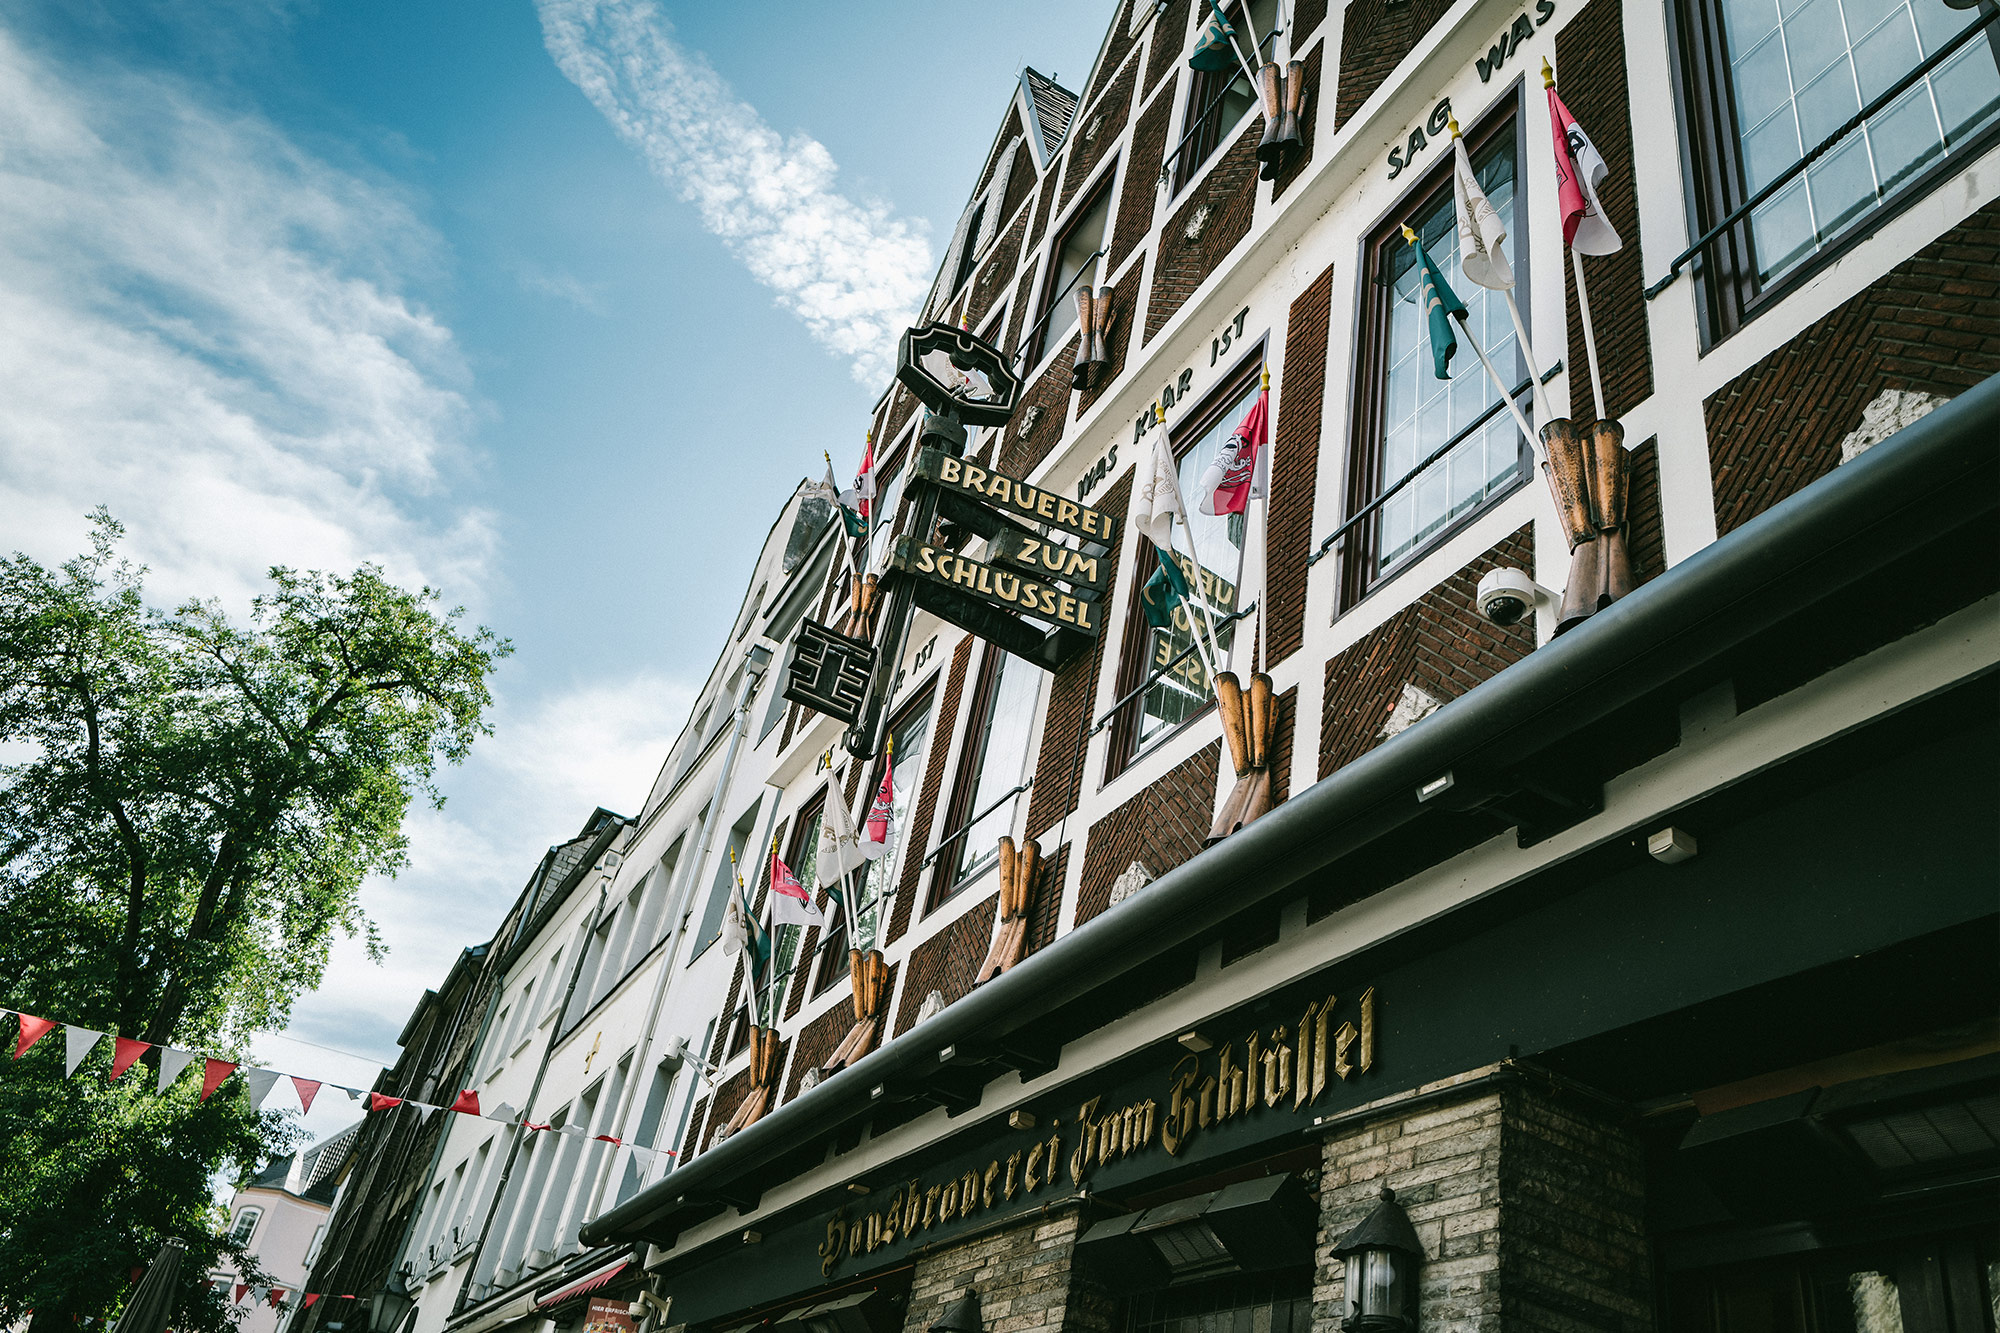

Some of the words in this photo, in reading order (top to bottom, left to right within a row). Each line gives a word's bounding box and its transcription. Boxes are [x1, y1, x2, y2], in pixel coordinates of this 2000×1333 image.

[1387, 97, 1452, 181] SAG
[1475, 0, 1555, 83] WAS
[1077, 444, 1119, 503] WAS
[1133, 367, 1194, 445] KLAR
[1210, 305, 1250, 368] IST
[940, 457, 1113, 540] BRAUEREI
[916, 547, 1092, 629] SCHLÜSSEL
[1016, 538, 1099, 583] ZUM
[912, 635, 938, 676] IST
[818, 1117, 1061, 1278] Hausbrauerei
